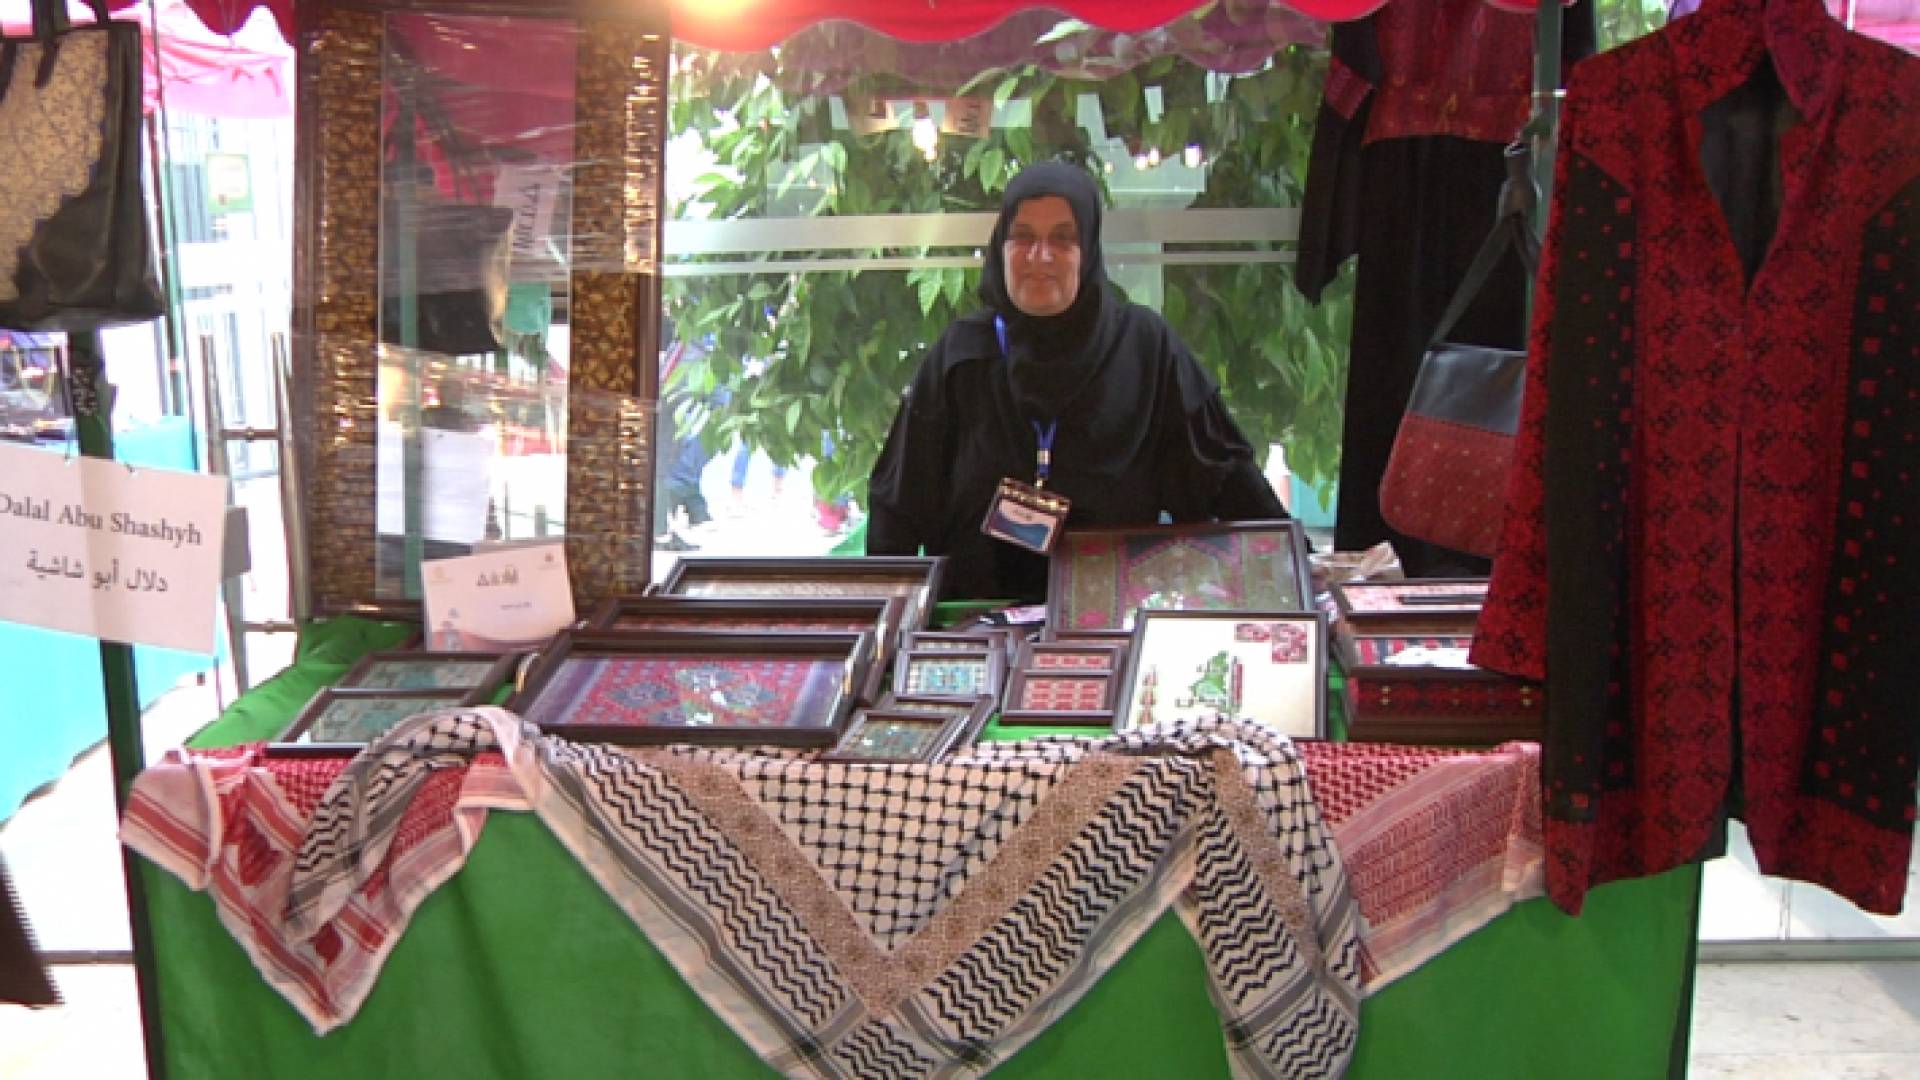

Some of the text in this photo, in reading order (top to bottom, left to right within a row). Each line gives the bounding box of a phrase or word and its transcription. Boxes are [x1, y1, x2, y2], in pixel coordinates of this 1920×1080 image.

[57, 504, 103, 529] Abu
[110, 512, 201, 548] Shashyh
[26, 550, 168, 592] دلال أبو شاشية
